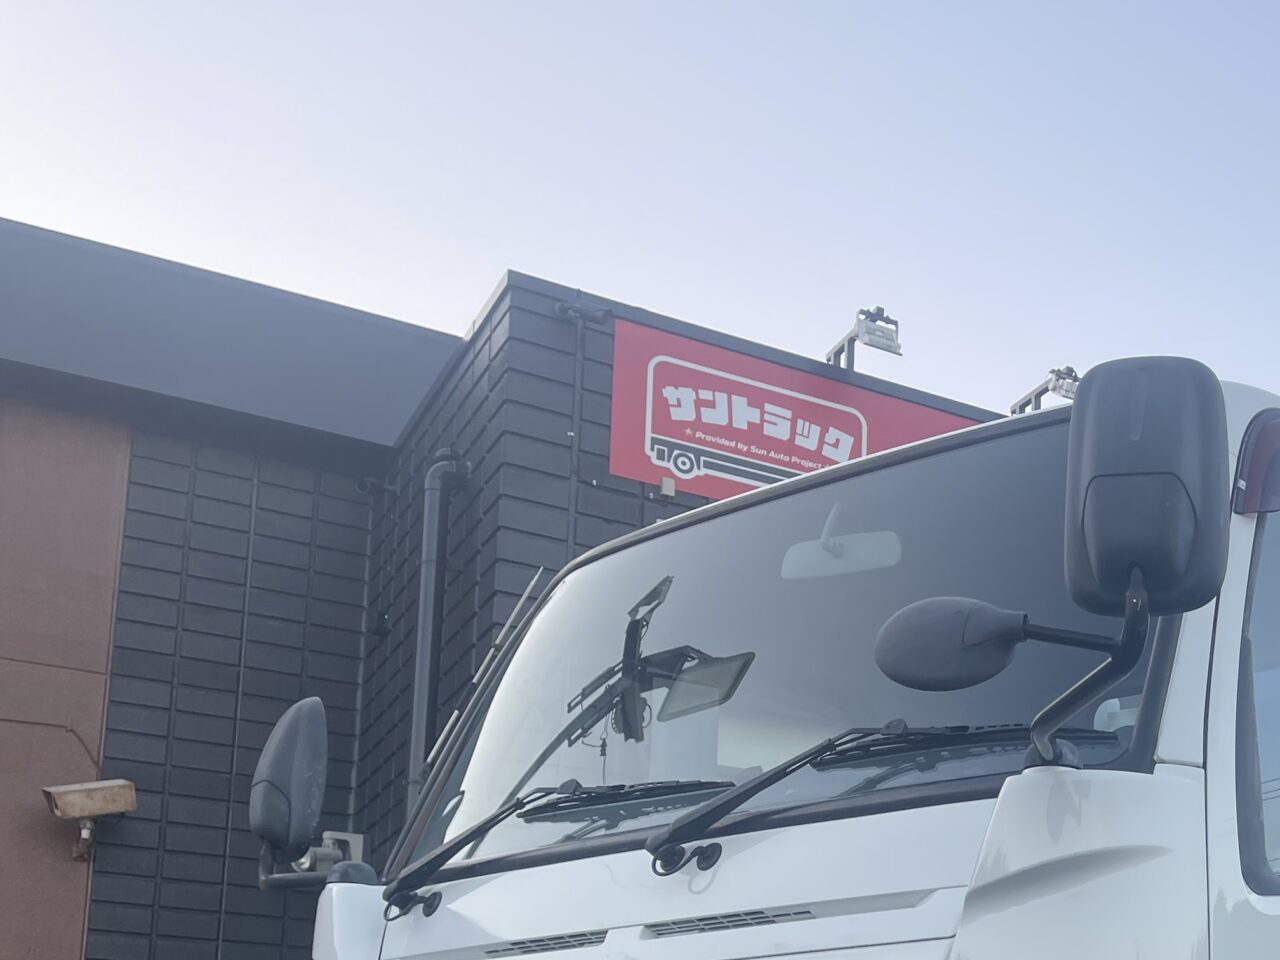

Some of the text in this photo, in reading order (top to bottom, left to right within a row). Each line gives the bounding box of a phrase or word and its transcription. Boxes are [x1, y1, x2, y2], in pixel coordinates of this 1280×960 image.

[662, 385, 855, 462] サントラック
[695, 431, 823, 470] Provided by Sun Auto Project
